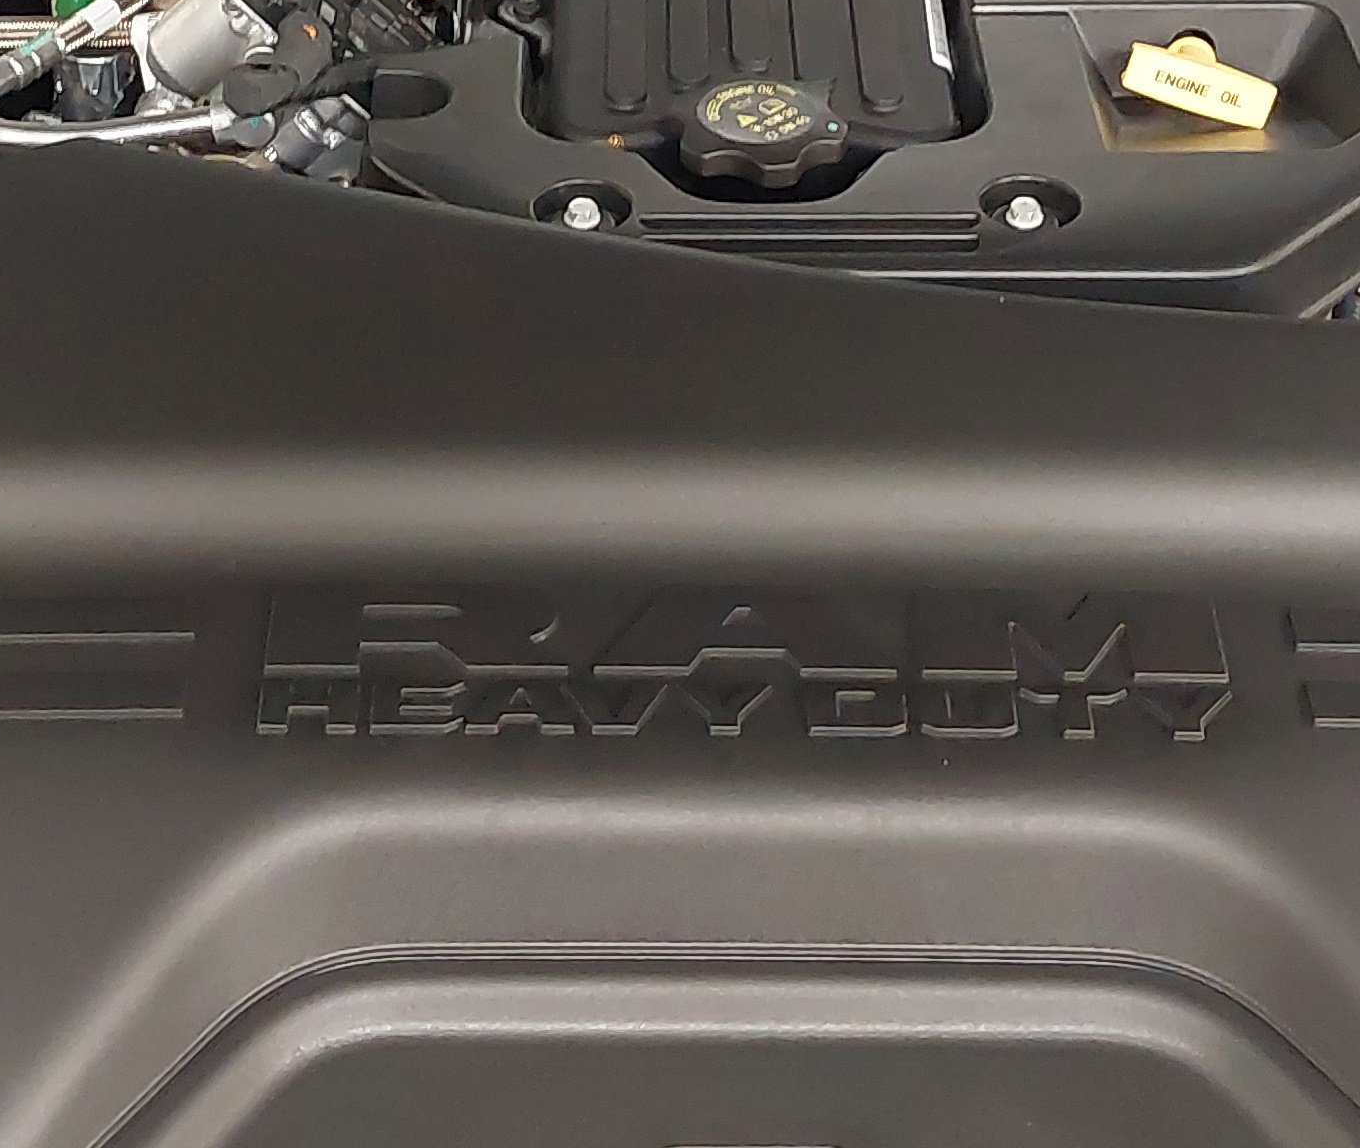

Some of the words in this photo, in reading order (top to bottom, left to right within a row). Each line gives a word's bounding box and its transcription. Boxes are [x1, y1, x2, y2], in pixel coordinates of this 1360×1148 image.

[1154, 69, 1211, 98] ENGINE
[1220, 90, 1242, 109] OIL
[261, 581, 1231, 683] RAM
[255, 679, 774, 738] HEAVY
[807, 679, 1233, 741] DUTY
